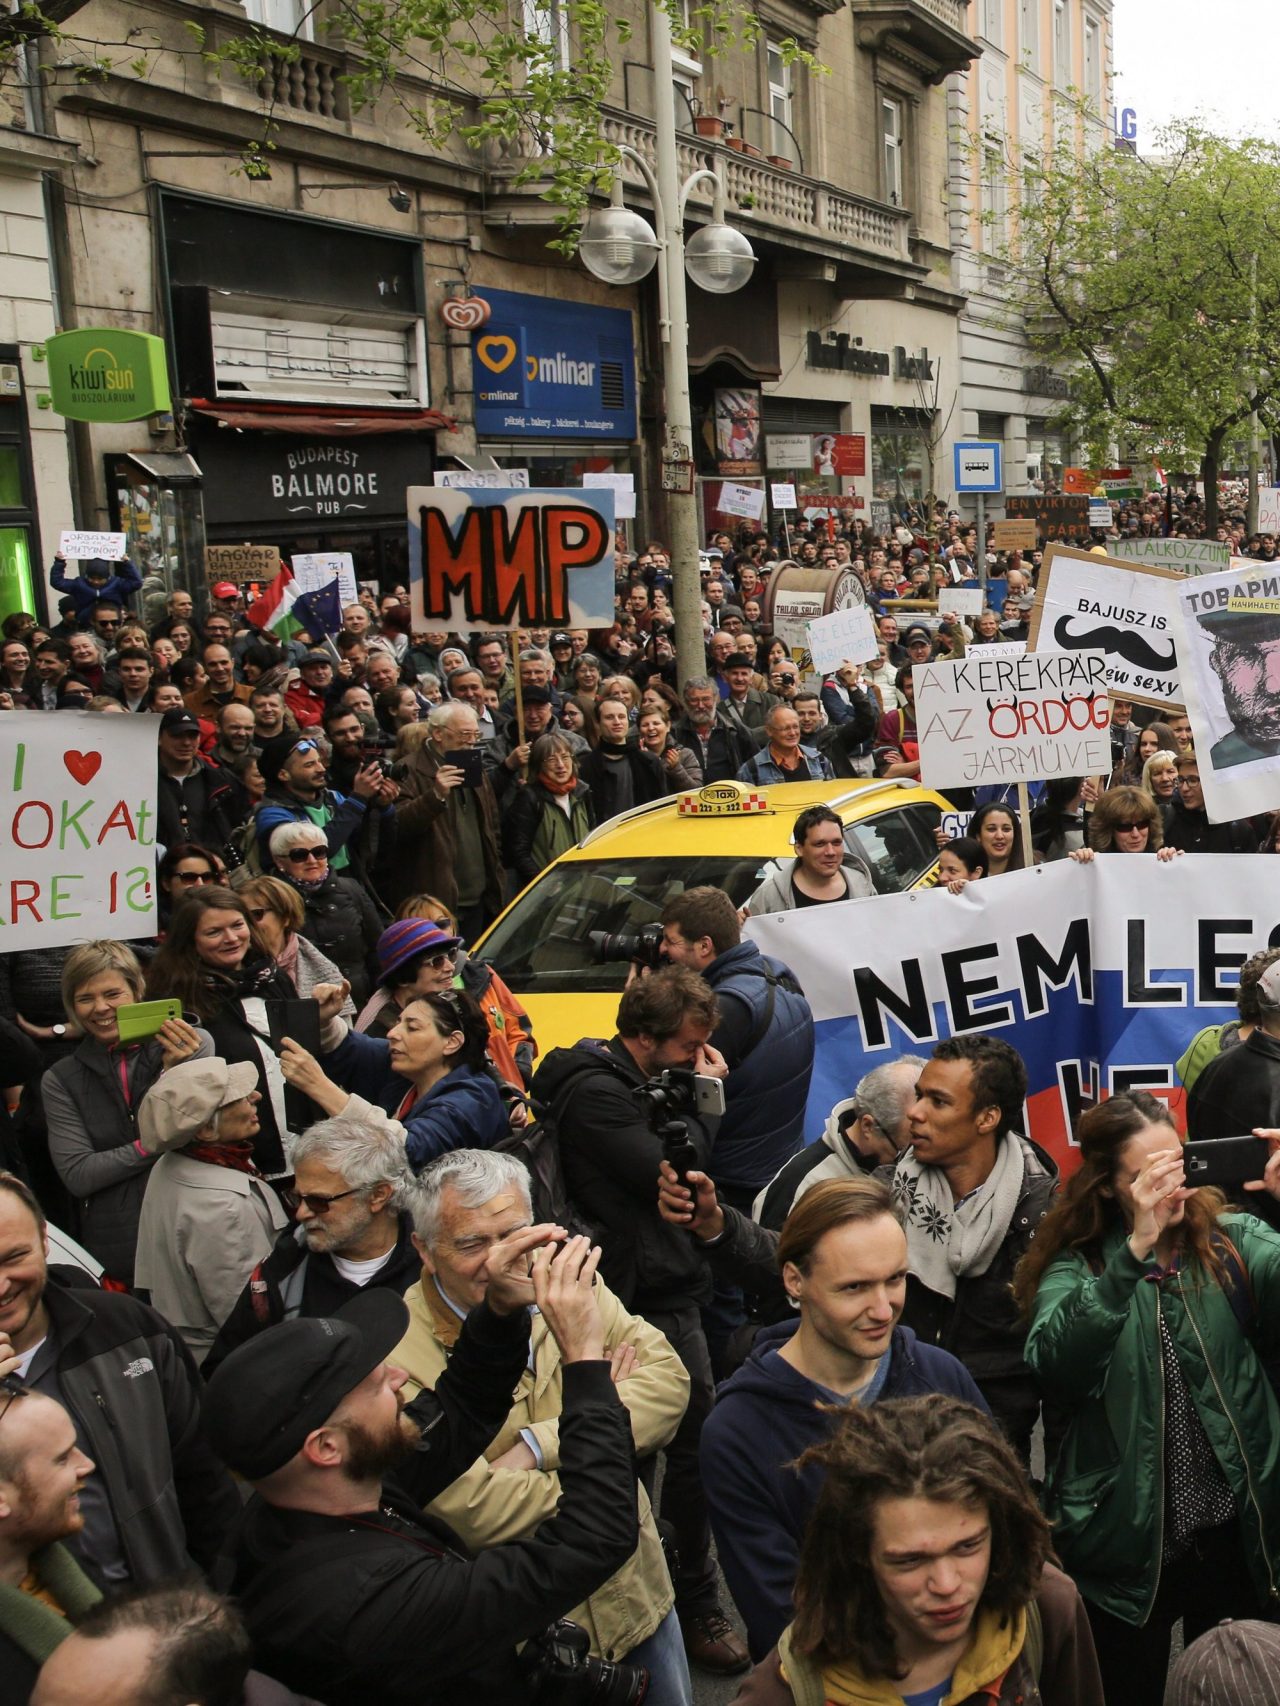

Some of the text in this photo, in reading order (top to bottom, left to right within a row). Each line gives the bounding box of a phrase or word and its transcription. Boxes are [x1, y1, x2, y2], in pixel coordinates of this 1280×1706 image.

[69, 363, 134, 390] kiwisun
[539, 352, 595, 387] mlinar
[488, 390, 519, 401] mlinar
[287, 446, 359, 469] BUDAPEST
[272, 473, 378, 498] BALMORE
[316, 501, 340, 514] PUB
[207, 549, 275, 561] MAGYAR
[420, 505, 609, 628] МИР
[776, 605, 799, 614] TAILOR
[1078, 598, 1166, 629] BAJUSZ IS
[920, 657, 1107, 699] A KERÉKPÁR
[922, 692, 1110, 744] AZ ÖRDÖG
[13, 743, 25, 791] I
[854, 918, 1093, 1047] NEM
